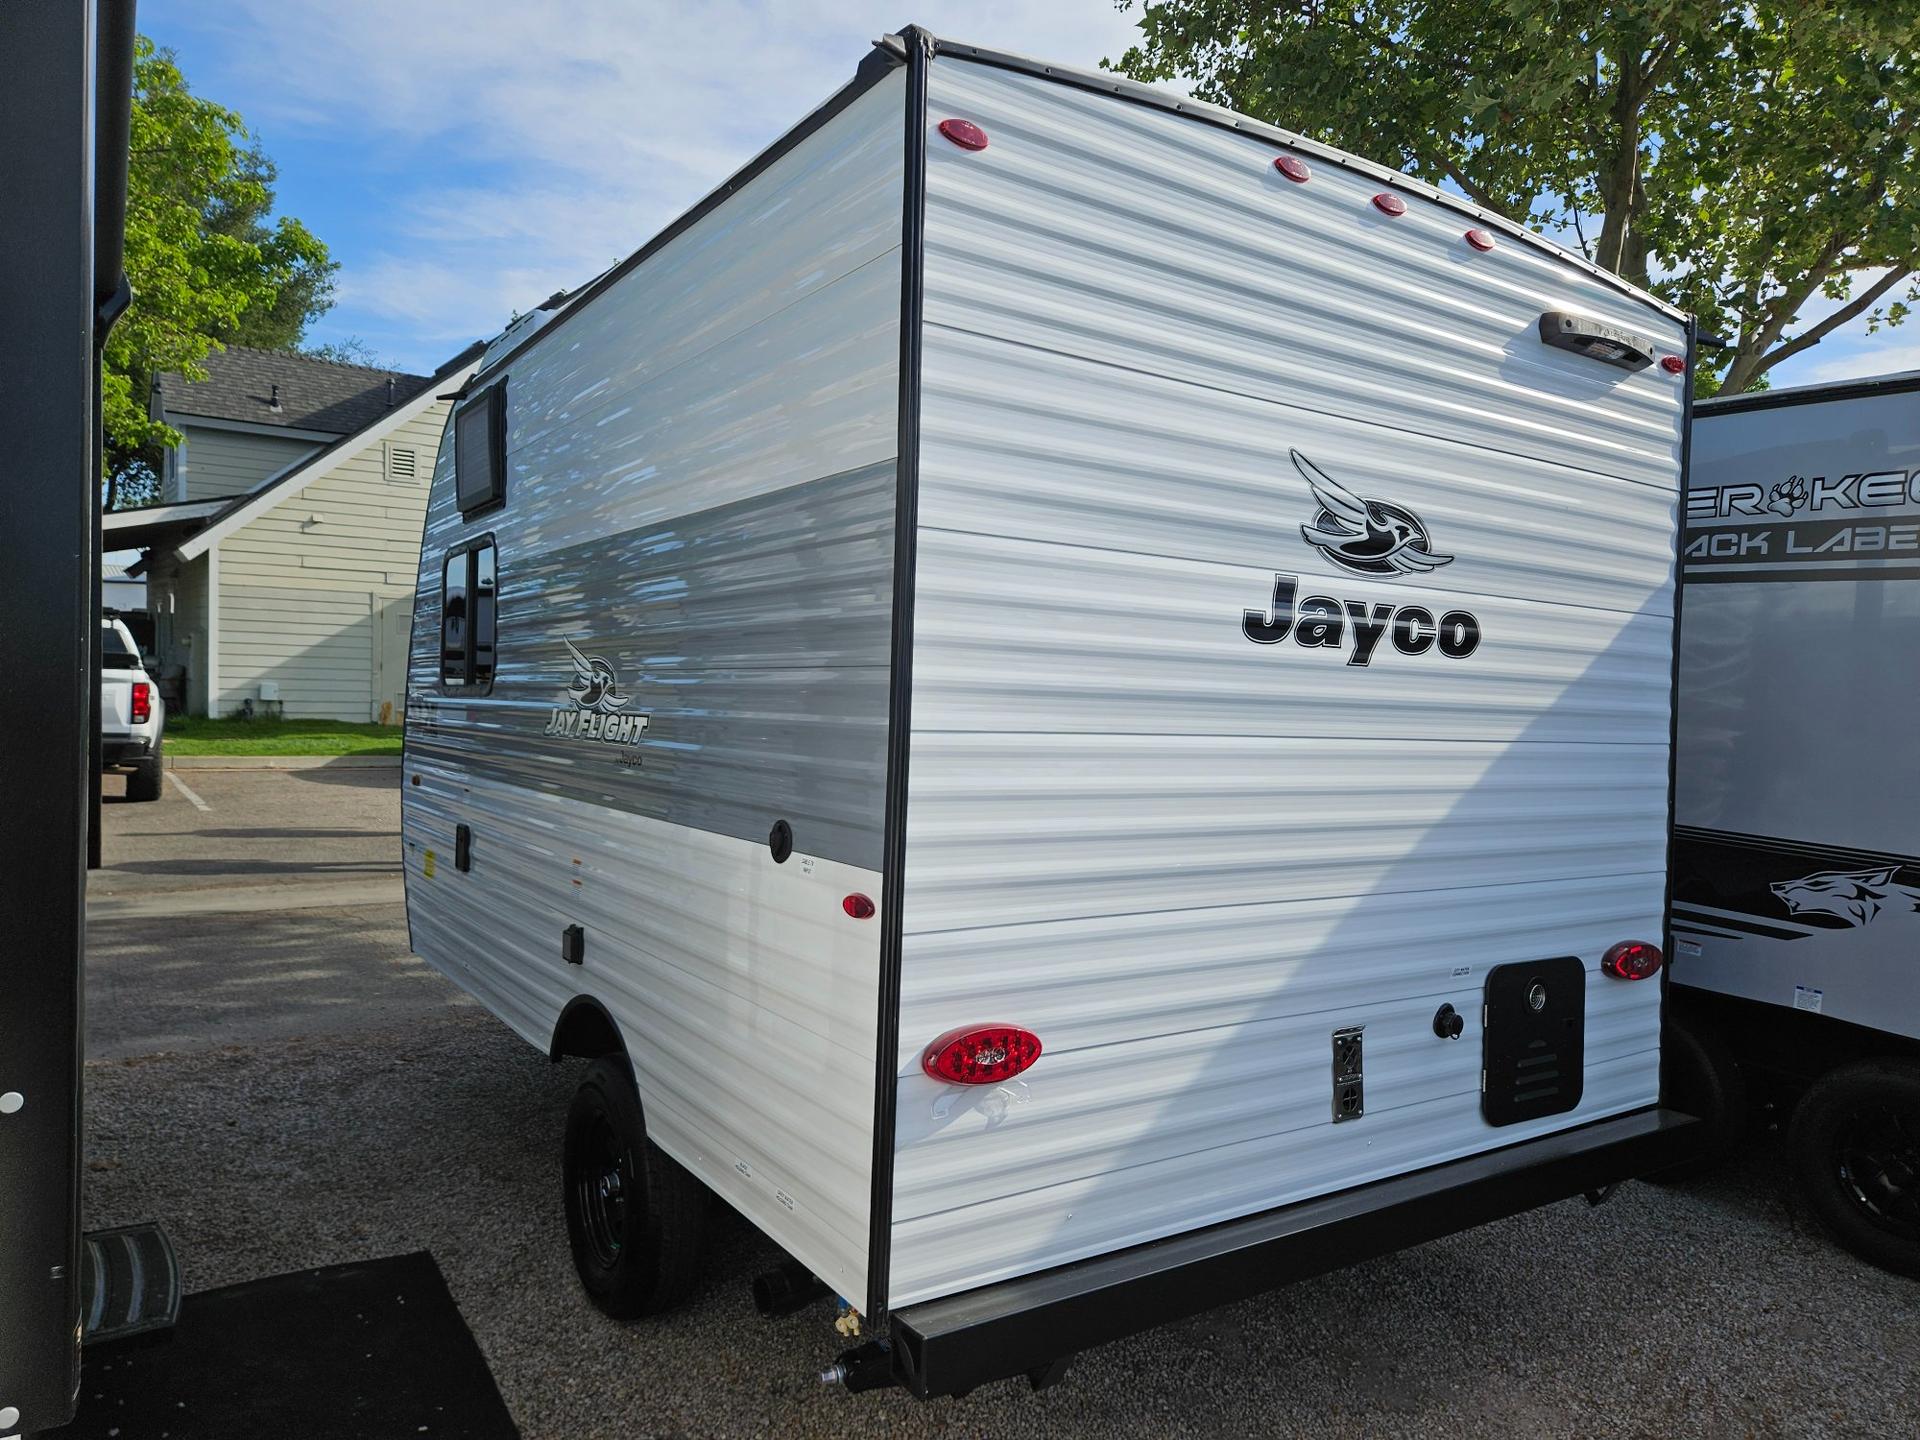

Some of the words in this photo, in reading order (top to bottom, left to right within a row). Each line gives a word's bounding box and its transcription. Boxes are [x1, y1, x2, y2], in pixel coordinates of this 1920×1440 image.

[1242, 573, 1482, 667] Jayco
[544, 707, 577, 737] JAY
[576, 709, 651, 745] FLIGHT
